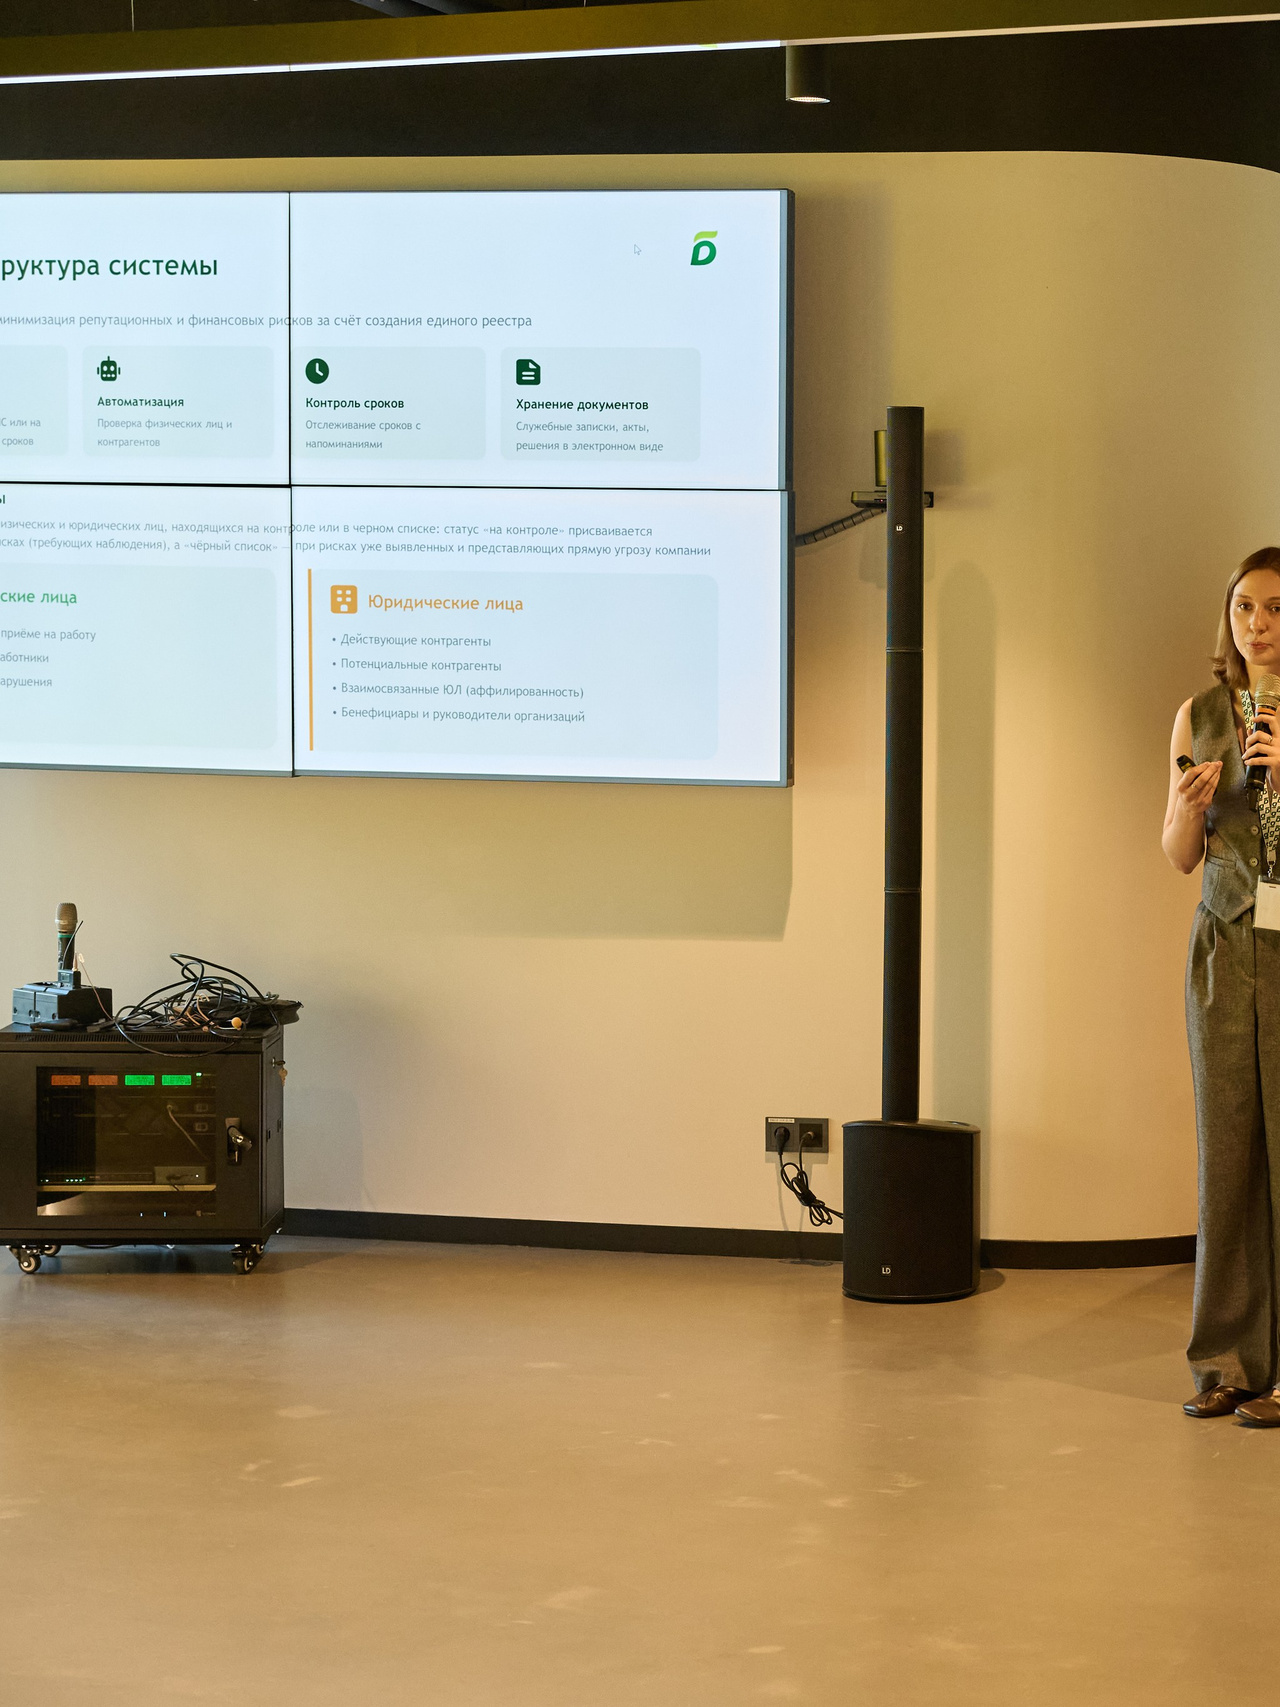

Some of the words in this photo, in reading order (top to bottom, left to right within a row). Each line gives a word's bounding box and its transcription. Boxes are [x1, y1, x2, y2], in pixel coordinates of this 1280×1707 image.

[2, 258, 100, 281] руктура
[108, 258, 219, 277] системы
[79, 315, 173, 329] репутационных
[177, 316, 184, 325] и
[188, 313, 264, 329] финансовых
[268, 315, 313, 328] рисков
[317, 317, 331, 327] за
[334, 314, 361, 327] счёт
[365, 316, 422, 328] создания
[426, 316, 478, 329] единого
[482, 316, 532, 329] реестра
[97, 395, 185, 409] Автоматизация
[305, 397, 361, 411] Контроль
[364, 399, 405, 411] сроков
[516, 398, 574, 412] Хранение
[577, 400, 649, 412] документов
[10, 419, 27, 427] или
[30, 418, 41, 427] на
[97, 417, 142, 430] Проверка
[145, 418, 203, 431] физических
[206, 419, 224, 430] лиц
[226, 419, 233, 428] и
[305, 419, 376, 431] Отслеживание
[379, 420, 413, 432] сроков
[416, 422, 421, 430] с
[516, 420, 573, 433] Служебные
[576, 422, 619, 433] записки,
[623, 422, 650, 433] акты,
[1, 437, 34, 448] сроков
[97, 437, 161, 448] контрагентов
[305, 439, 383, 449] напоминаниями
[516, 441, 560, 453] решения
[563, 442, 569, 450] в
[572, 441, 637, 453] электронном
[640, 442, 664, 453] виде
[59, 520, 66, 529] и
[69, 520, 140, 533] юридических
[144, 522, 168, 534] лиц,
[171, 522, 243, 534] находящихся
[247, 524, 260, 533] на
[263, 522, 316, 535] контроле
[319, 522, 339, 532] или
[343, 523, 350, 532] в
[353, 523, 394, 535] черном
[397, 524, 440, 536] списке:
[443, 524, 479, 536] статус
[568, 526, 653, 538] присваивается
[29, 536, 92, 550] (требующих
[96, 537, 170, 552] наблюдения),
[174, 540, 180, 550] а
[296, 541, 315, 553] при
[319, 541, 356, 553] рисках
[360, 542, 382, 553] уже
[385, 543, 454, 553] выявленных
[458, 543, 464, 552] и
[468, 543, 564, 556] представляющих
[568, 545, 611, 557] прямую
[614, 545, 651, 558] угрозу
[655, 546, 711, 556] компании
[40, 592, 78, 607] лица
[368, 594, 480, 612] Юридические
[485, 596, 524, 613] лица
[1, 627, 41, 640] приёме
[44, 630, 56, 639] на
[60, 629, 96, 642] работу
[340, 632, 417, 647] Действующие
[421, 636, 492, 648] контрагенты
[341, 657, 428, 672] Потенциальные
[432, 659, 502, 673] контрагенты
[341, 681, 439, 696] Взаимосвязанные
[443, 684, 463, 696] ЮЛ
[466, 684, 584, 699] (аффилированность)
[341, 706, 419, 721] Бенефициары
[422, 709, 429, 719] и
[433, 708, 511, 723] руководители
[514, 708, 586, 724] организаций
[881, 1267, 891, 1275] LD
